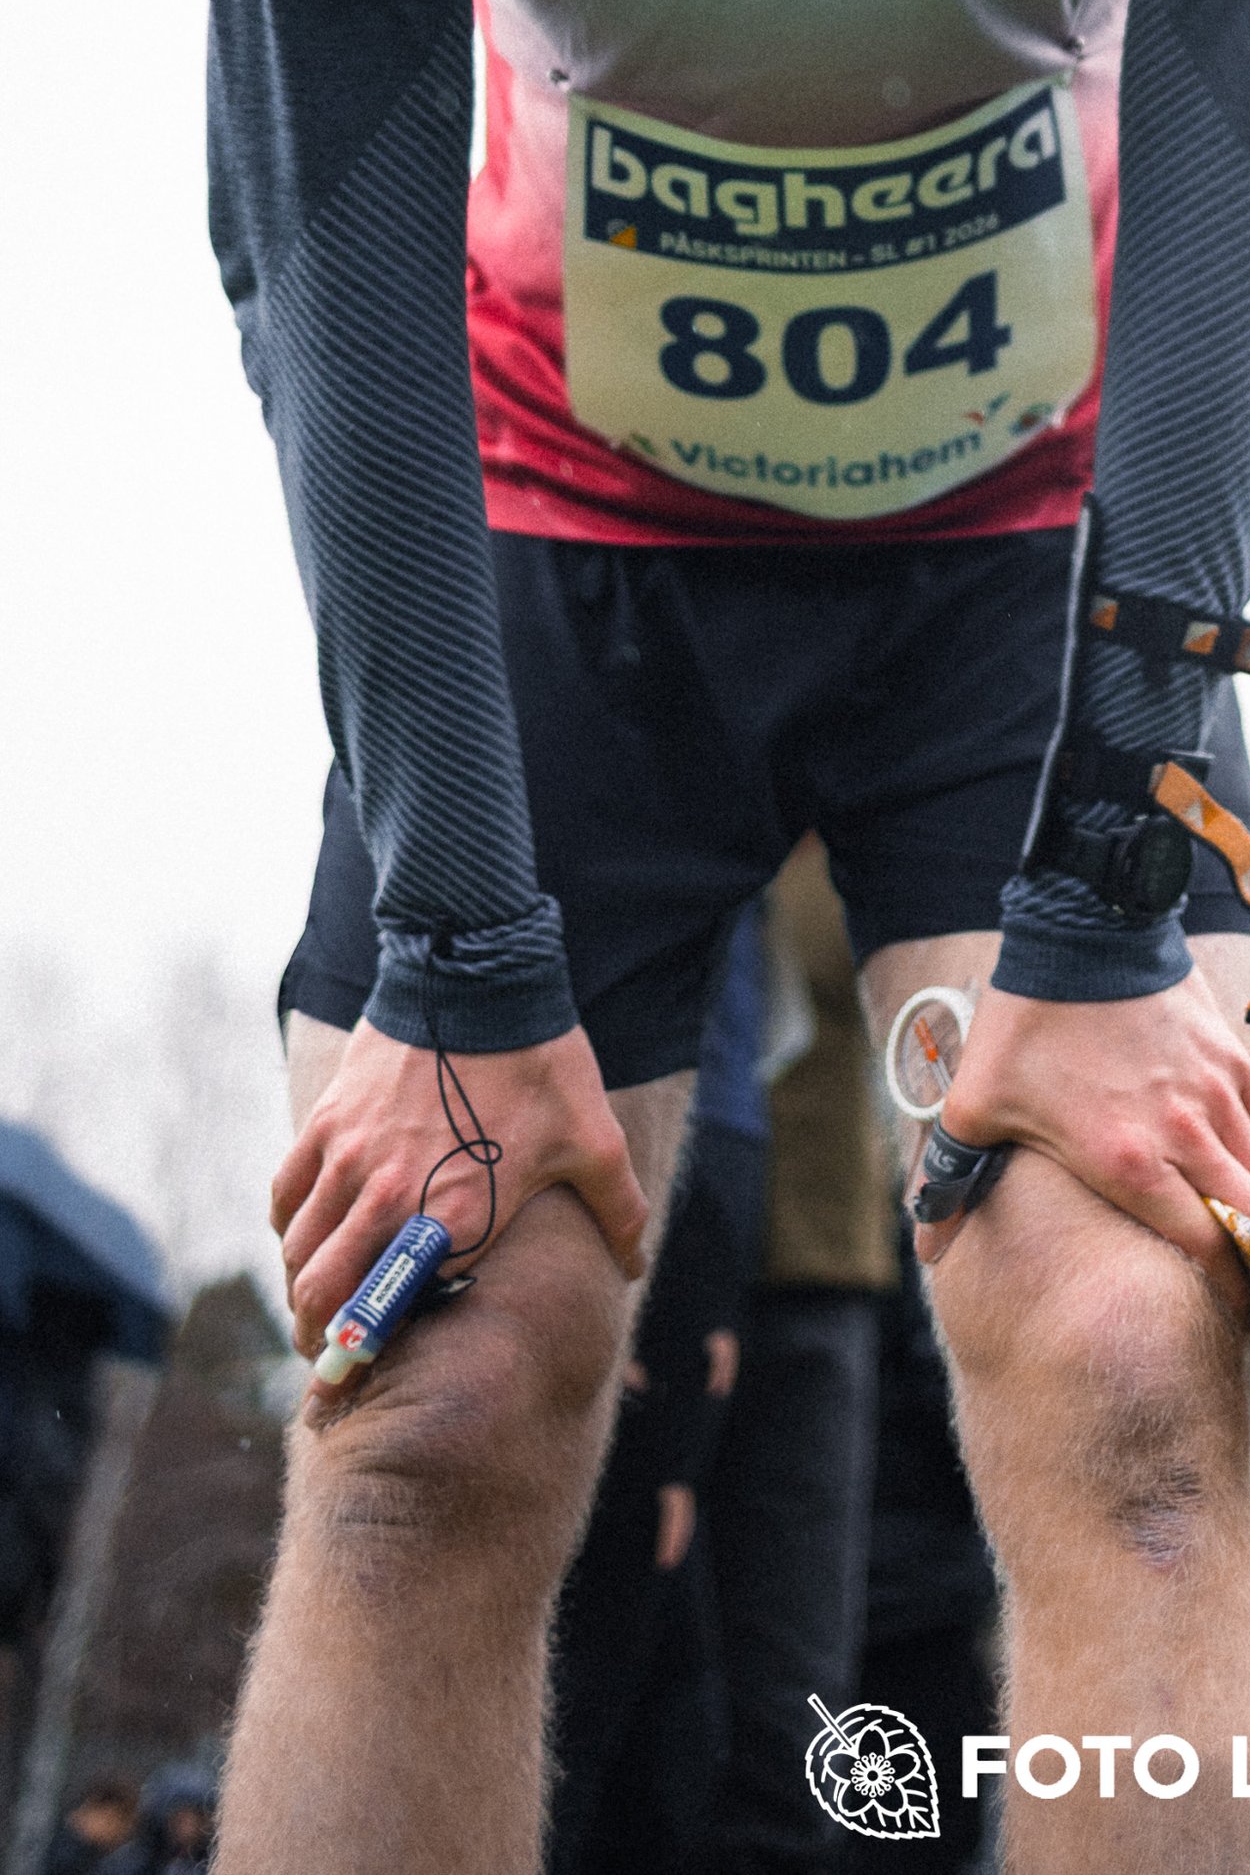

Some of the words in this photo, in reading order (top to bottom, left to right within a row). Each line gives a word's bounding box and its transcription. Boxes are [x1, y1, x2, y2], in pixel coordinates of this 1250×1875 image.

[591, 106, 1057, 237] bagheera
[659, 231, 847, 268] PÅSKSPRINTEN
[658, 269, 1012, 407] 804
[671, 431, 982, 489] Victoriahem
